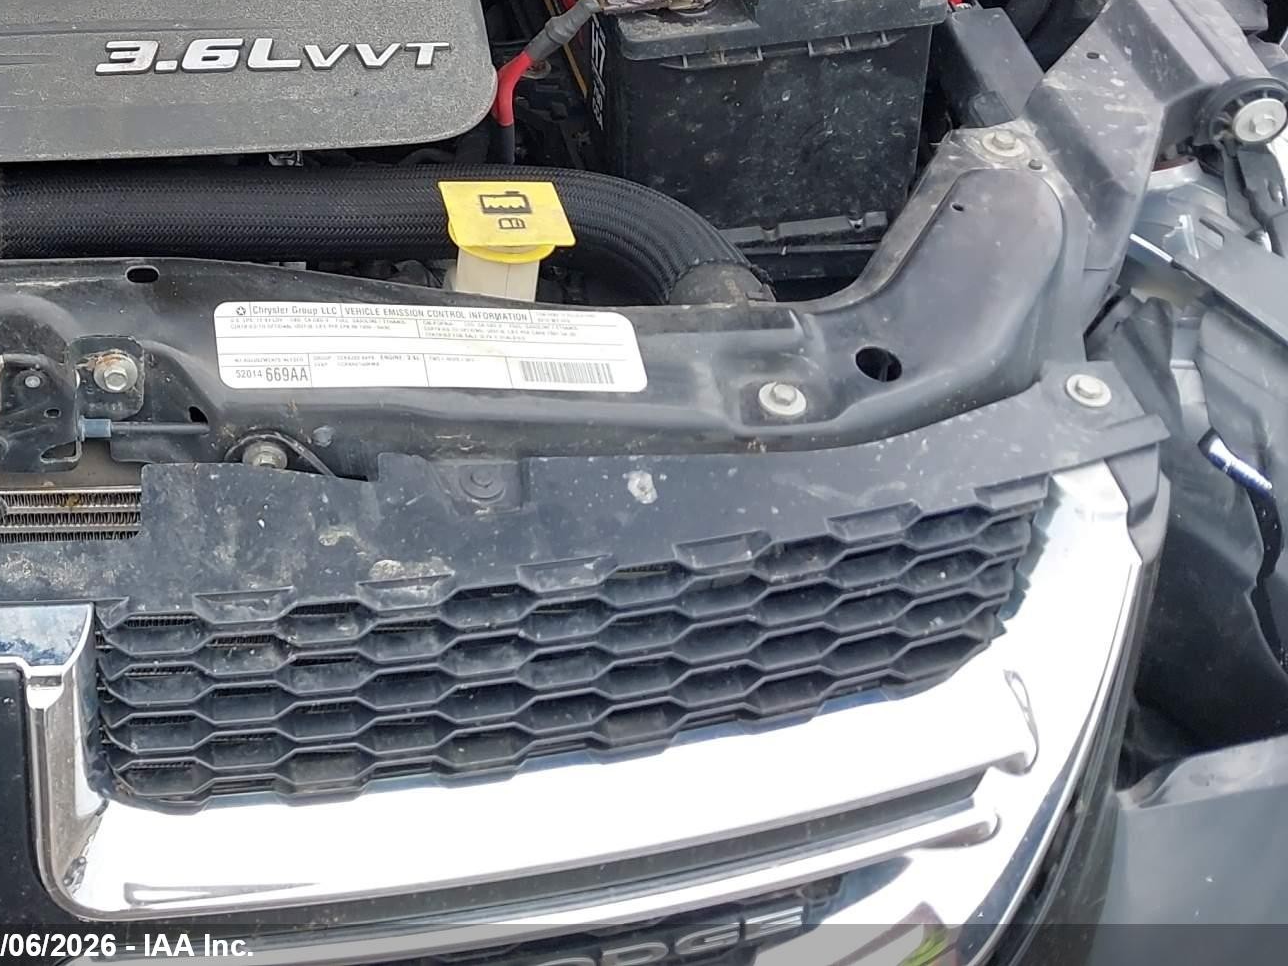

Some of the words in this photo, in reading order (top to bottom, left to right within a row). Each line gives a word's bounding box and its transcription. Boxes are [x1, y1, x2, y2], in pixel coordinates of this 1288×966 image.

[252, 306, 289, 317] Chrysler
[292, 306, 319, 317] Group
[321, 306, 338, 316] LLC
[345, 307, 381, 317] VEHICLE
[383, 308, 425, 318] EMISSION
[428, 309, 465, 319] CONTROL
[469, 311, 528, 322] INFORMATION
[235, 369, 263, 379] 52014
[265, 366, 309, 383] 669AA
